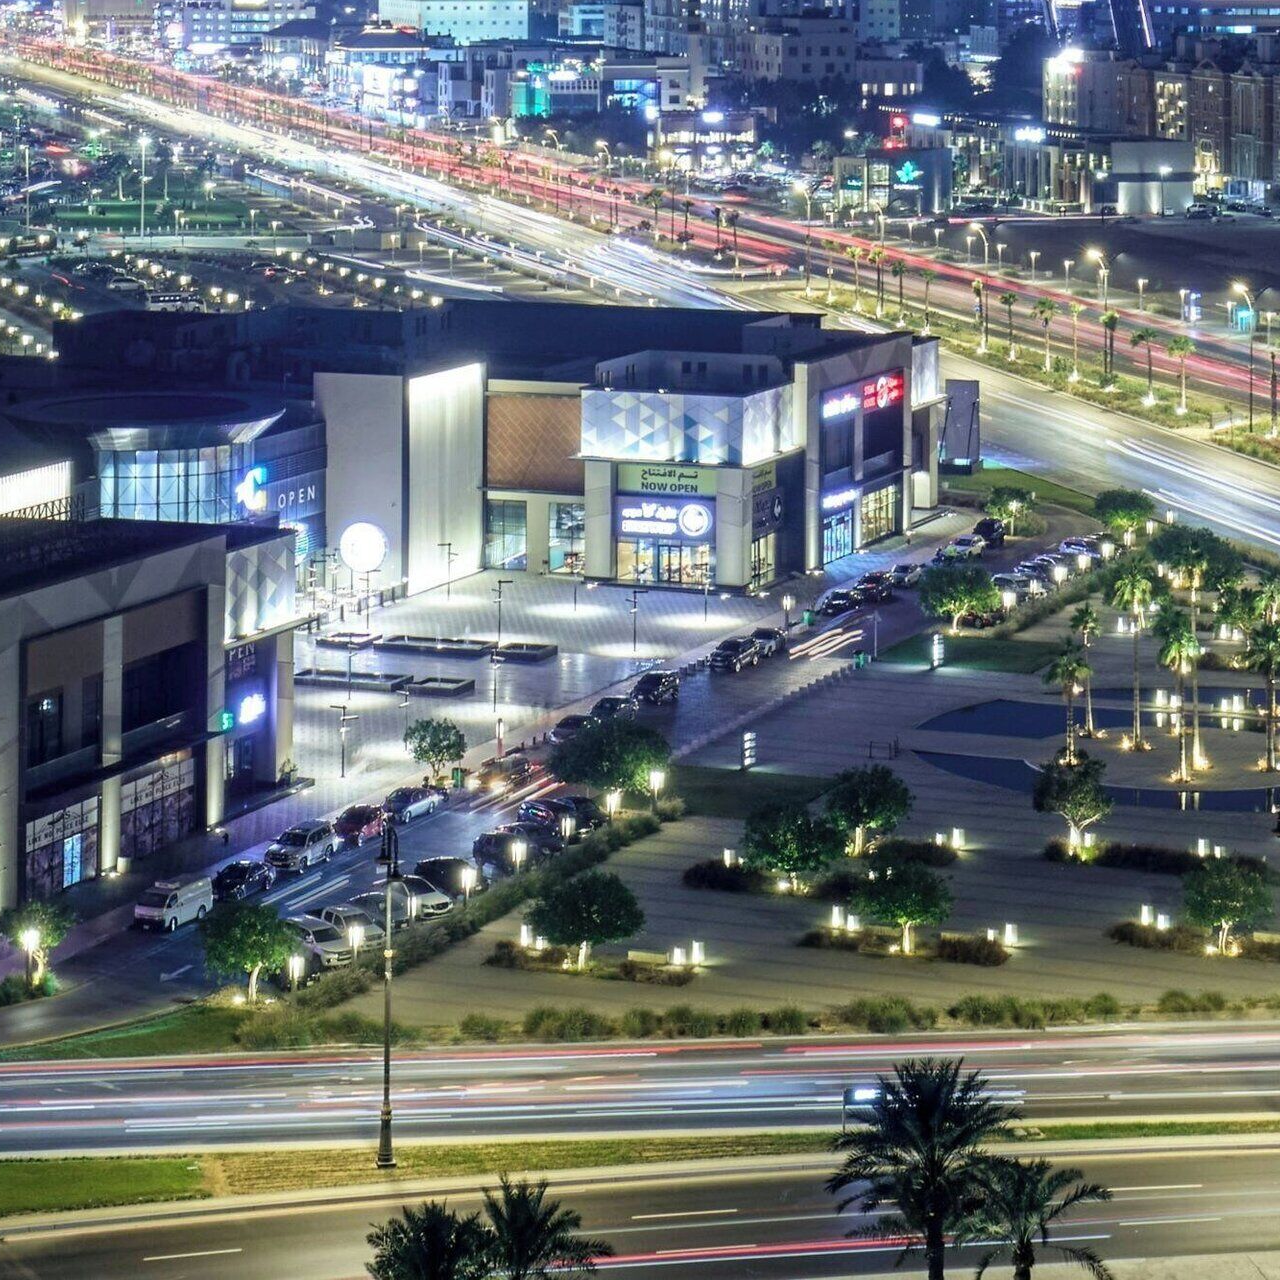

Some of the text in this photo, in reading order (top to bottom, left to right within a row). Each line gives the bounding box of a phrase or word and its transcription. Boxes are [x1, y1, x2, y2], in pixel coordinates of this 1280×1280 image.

[641, 481, 698, 493] NOW OPEN
[277, 484, 316, 509] OPEN
